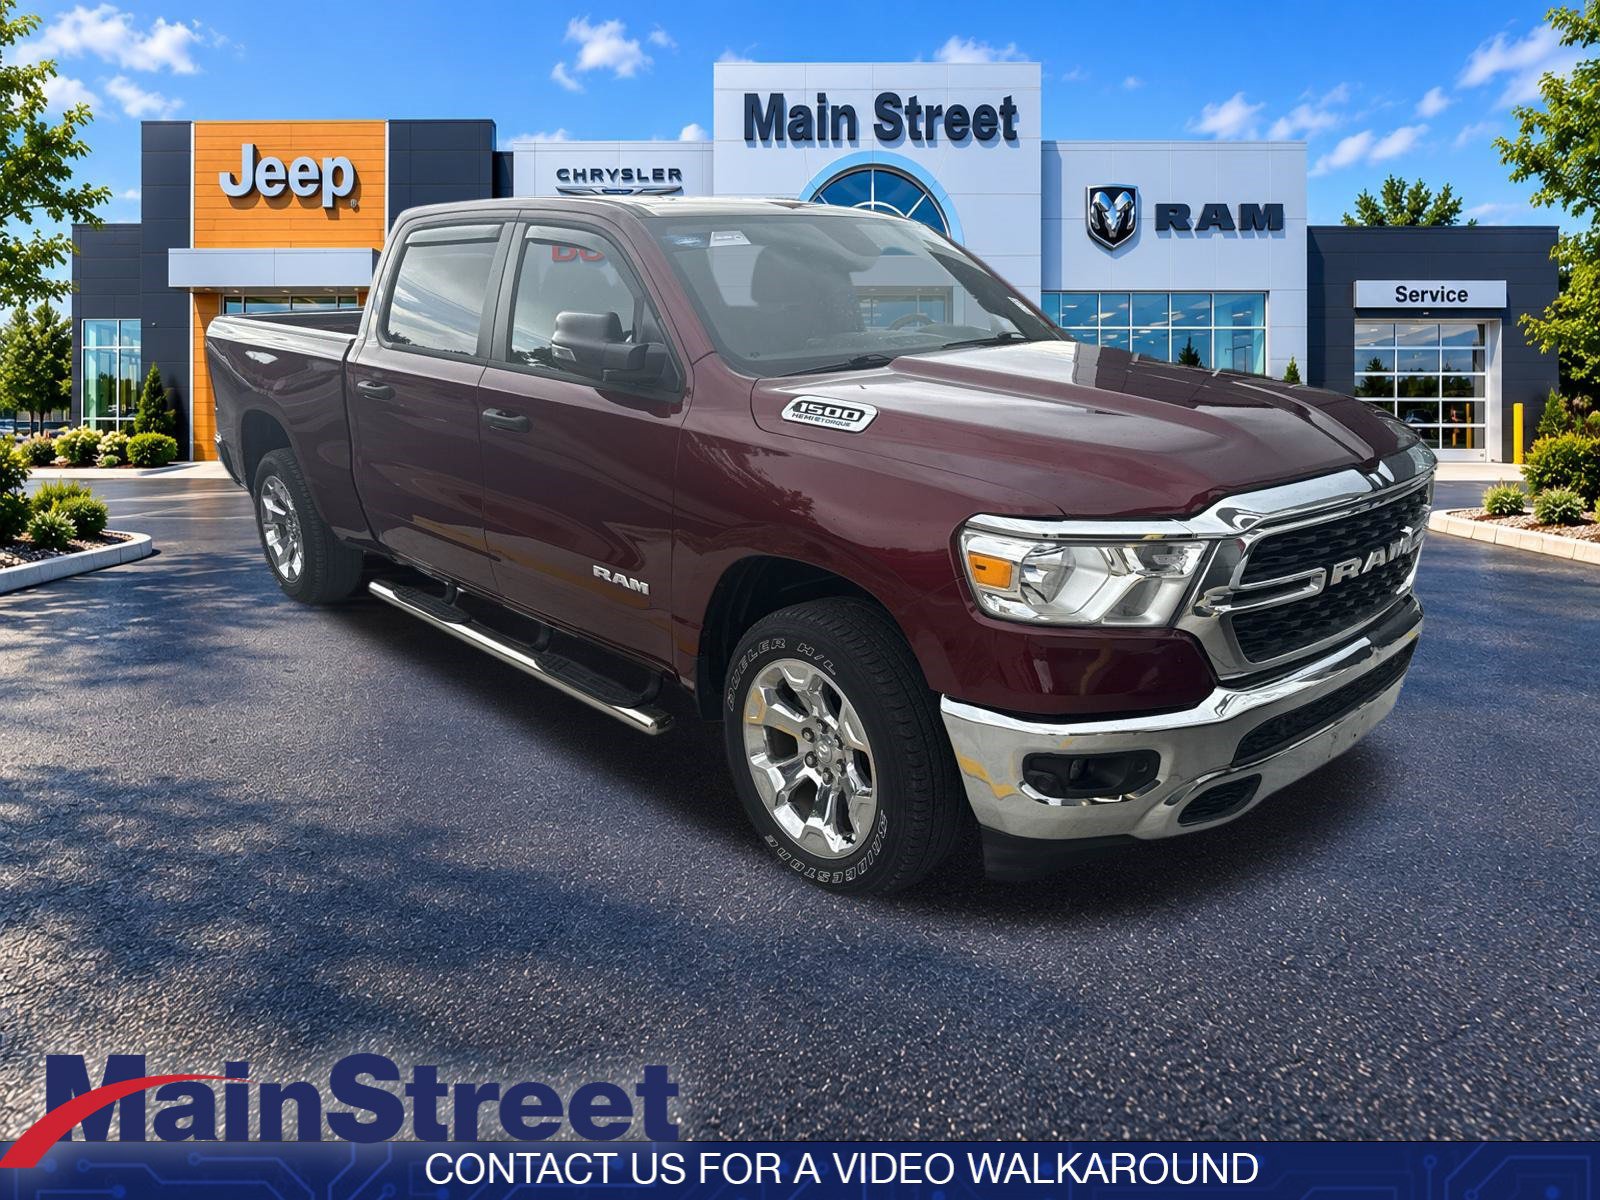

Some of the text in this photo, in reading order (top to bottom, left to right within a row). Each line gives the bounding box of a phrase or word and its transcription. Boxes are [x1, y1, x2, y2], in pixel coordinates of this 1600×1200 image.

[744, 92, 1018, 141] Main Street
[219, 143, 355, 208] Jeep
[556, 167, 684, 183] CHRYSLER
[1155, 203, 1284, 232] RAM
[1395, 285, 1469, 303] Service
[791, 412, 815, 422] HEMI
[799, 401, 861, 421] 1500
[1330, 533, 1413, 586] RAM
[592, 564, 650, 595] RAM
[726, 638, 837, 712] DUELER H/L
[764, 809, 889, 884] BRIDGESTONE
